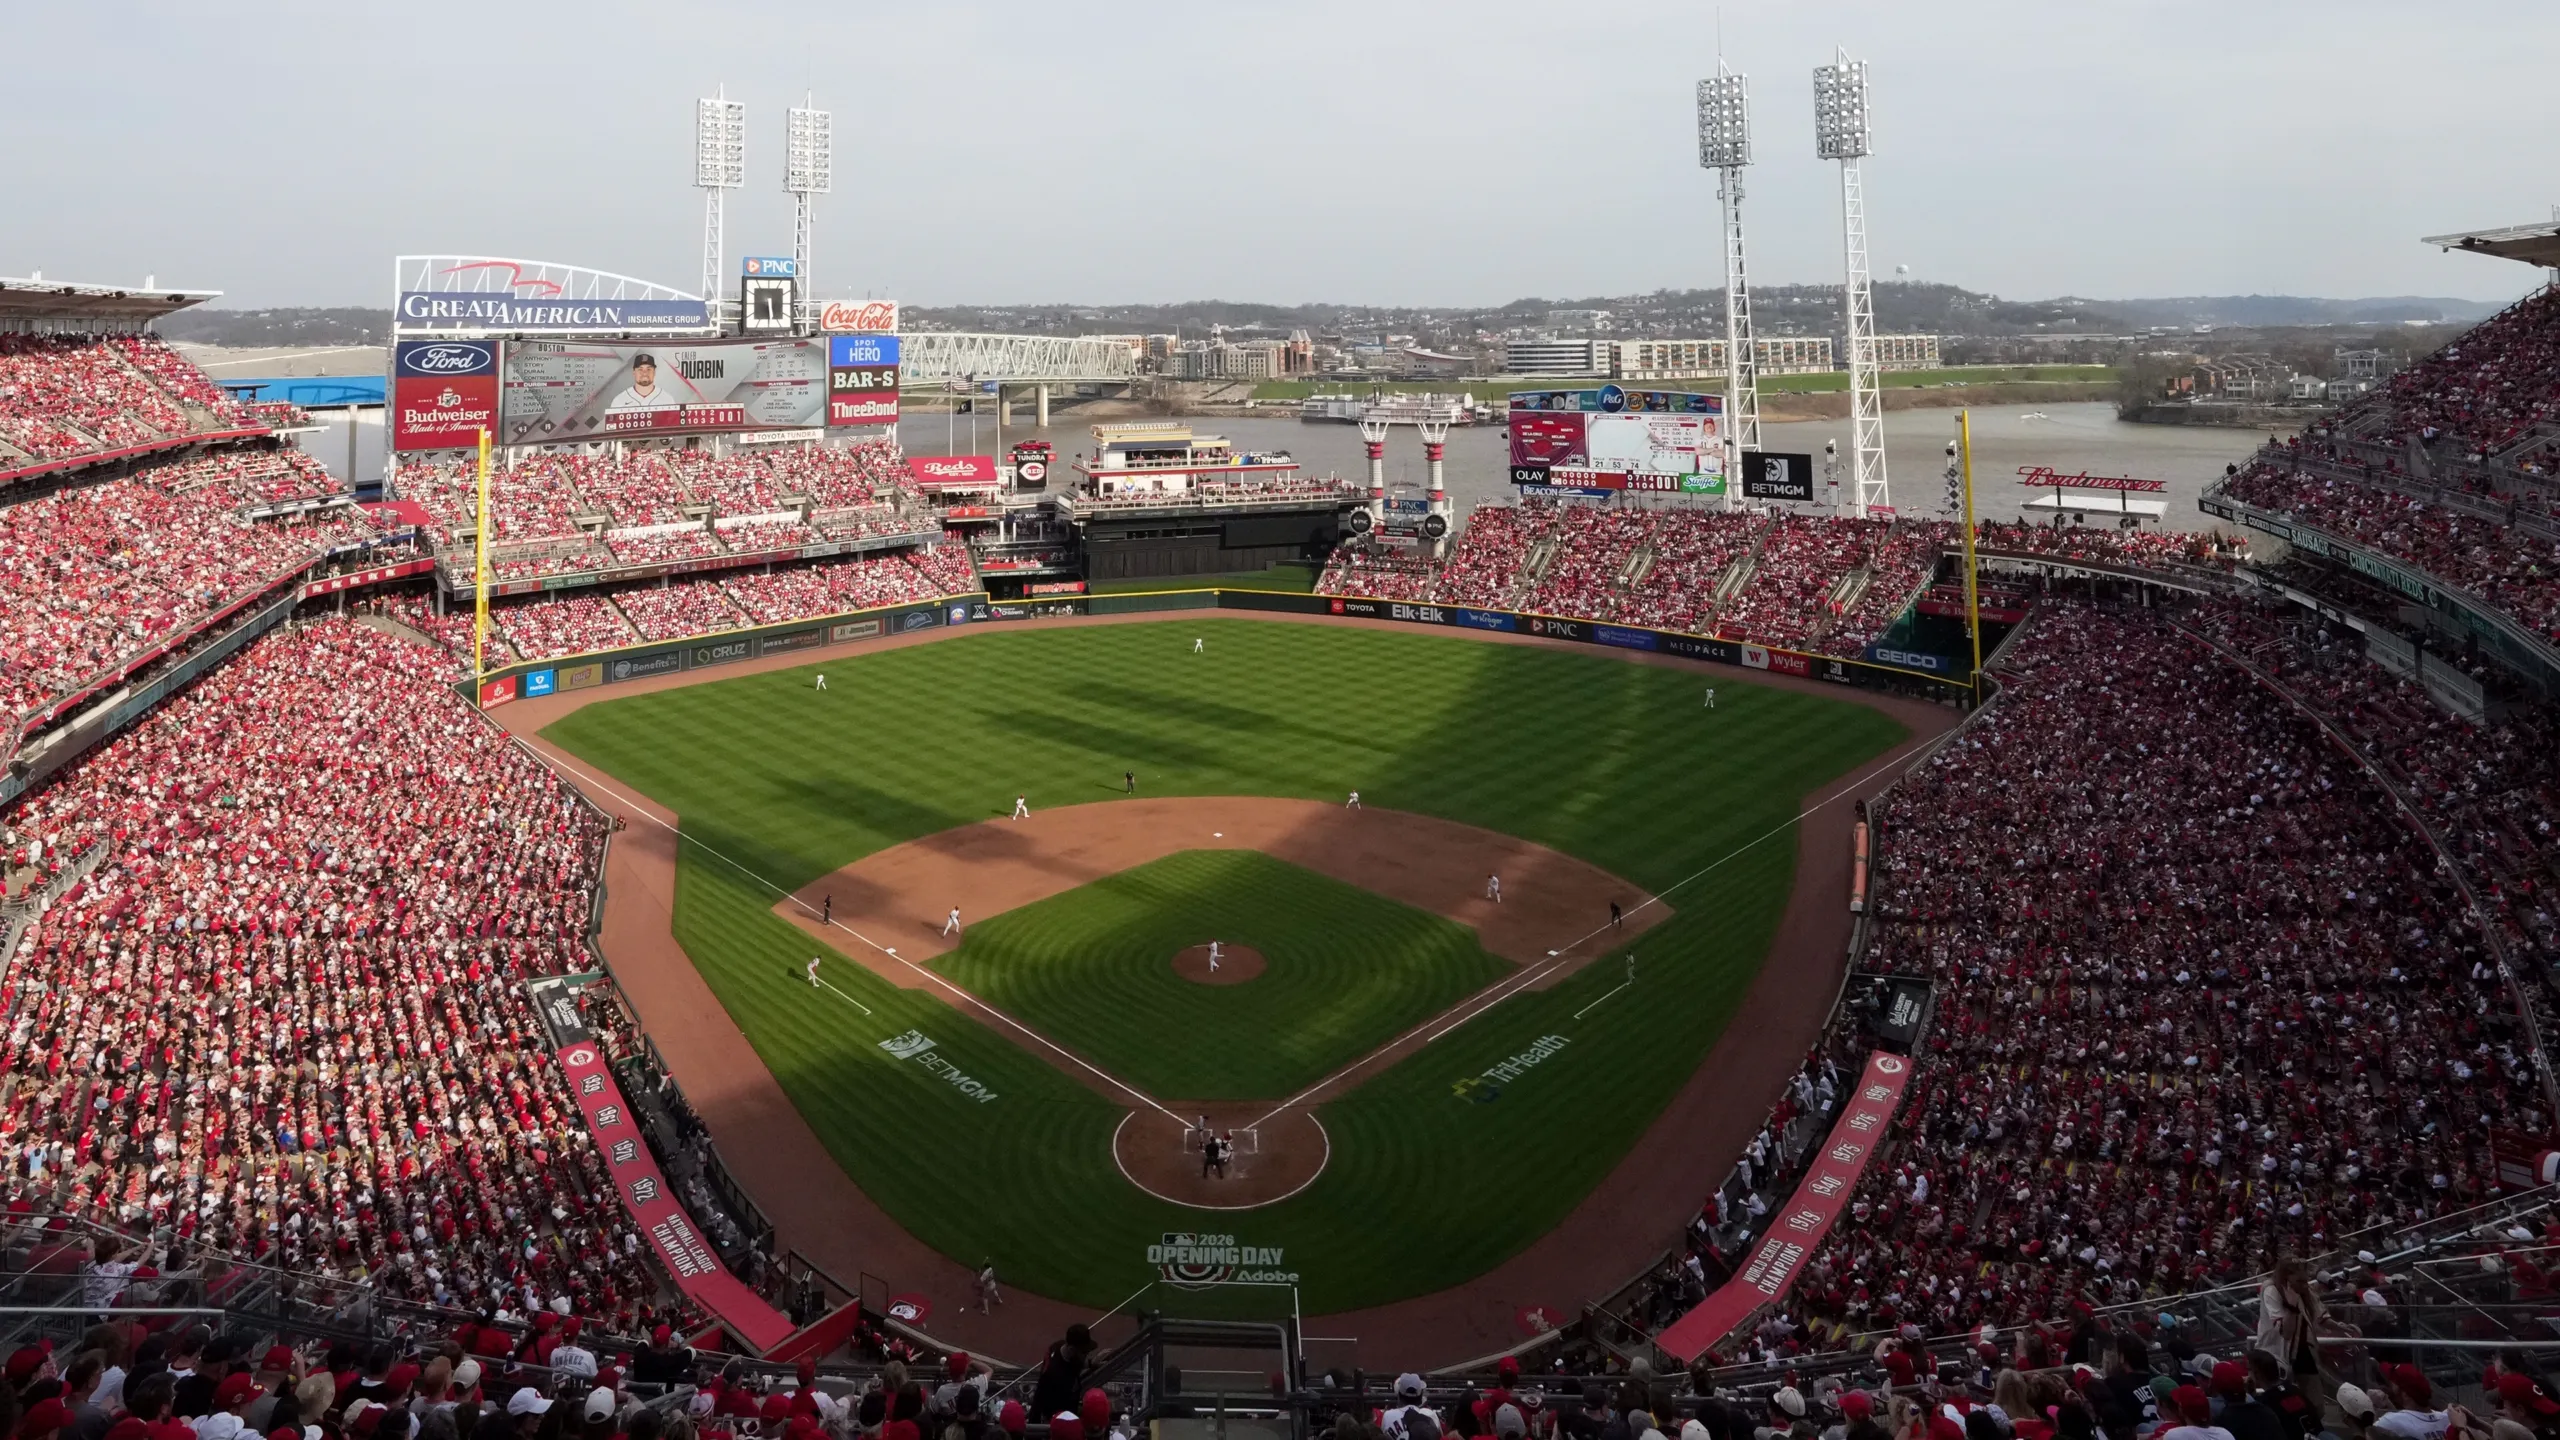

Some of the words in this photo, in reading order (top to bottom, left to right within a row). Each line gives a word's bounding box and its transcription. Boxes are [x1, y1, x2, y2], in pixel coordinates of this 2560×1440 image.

[762, 259, 793, 273] PNC
[404, 295, 499, 318] GREAT
[489, 302, 621, 324] AMERICAN
[627, 315, 673, 324] INSURANCE
[674, 315, 701, 324] GROUP
[822, 303, 897, 331] Coca-Cola
[538, 344, 566, 352] BOSTON
[854, 339, 876, 347] SPOT
[421, 347, 475, 369] Ford
[681, 351, 697, 360] CALEB
[849, 347, 881, 363] HERO
[681, 360, 724, 379] DURBIN
[834, 371, 894, 388] BAR-S
[1603, 393, 1621, 403] P&G
[404, 408, 489, 423] Budweiser
[832, 400, 897, 418] ThreeBond
[402, 423, 435, 434] Made
[1017, 454, 1045, 462] TUNDRA
[1261, 456, 1291, 464] TriHealth
[1612, 461, 1621, 469] 53
[924, 461, 978, 476] Reds
[1516, 470, 1544, 481] OLAY
[1683, 475, 1719, 489] Swiffer
[2017, 466, 2165, 491] Budweiser
[1523, 485, 1559, 496] BEACON
[1752, 483, 1804, 496] BETMGM
[1400, 501, 1420, 510] PNC
[2291, 530, 2330, 556] SAUSAGE
[2349, 551, 2401, 588] CINCINNATI
[2401, 575, 2424, 601] REDS
[1346, 603, 1374, 612] TOYOTA
[1479, 613, 1503, 628] Kroger
[1547, 621, 1577, 637] PNC
[712, 643, 746, 659] CRUZ
[1669, 641, 1726, 657] MEDPACE
[632, 659, 670, 673] Benefits
[1773, 654, 1806, 669] Wyler
[1876, 648, 1937, 669] GEICO
[1823, 673, 1850, 683] BETMGM
[482, 692, 515, 709] Budweiser
[1481, 1034, 1571, 1083] TriHealth
[916, 1051, 998, 1104] BETMGM
[1850, 1112, 1878, 1131] 1976
[614, 1139, 633, 1162] 1970
[1832, 1142, 1861, 1162] 1975
[632, 1178, 655, 1202] 1972
[1812, 1175, 1842, 1196] 1940
[1789, 1209, 1821, 1232] 1919
[666, 1213, 696, 1247] NATIONAL
[689, 1244, 717, 1274] LEAGUE
[1199, 1233, 1235, 1246] 2026
[652, 1223, 699, 1278] CHAMPIONS
[1147, 1244, 1240, 1265] OPENING
[1241, 1247, 1284, 1266] DAY
[1742, 1259, 1768, 1284] WORLD
[1758, 1237, 1783, 1262] SERIES
[1757, 1242, 1804, 1295] CHAMPIONS
[1236, 1270, 1299, 1282] Adobe
